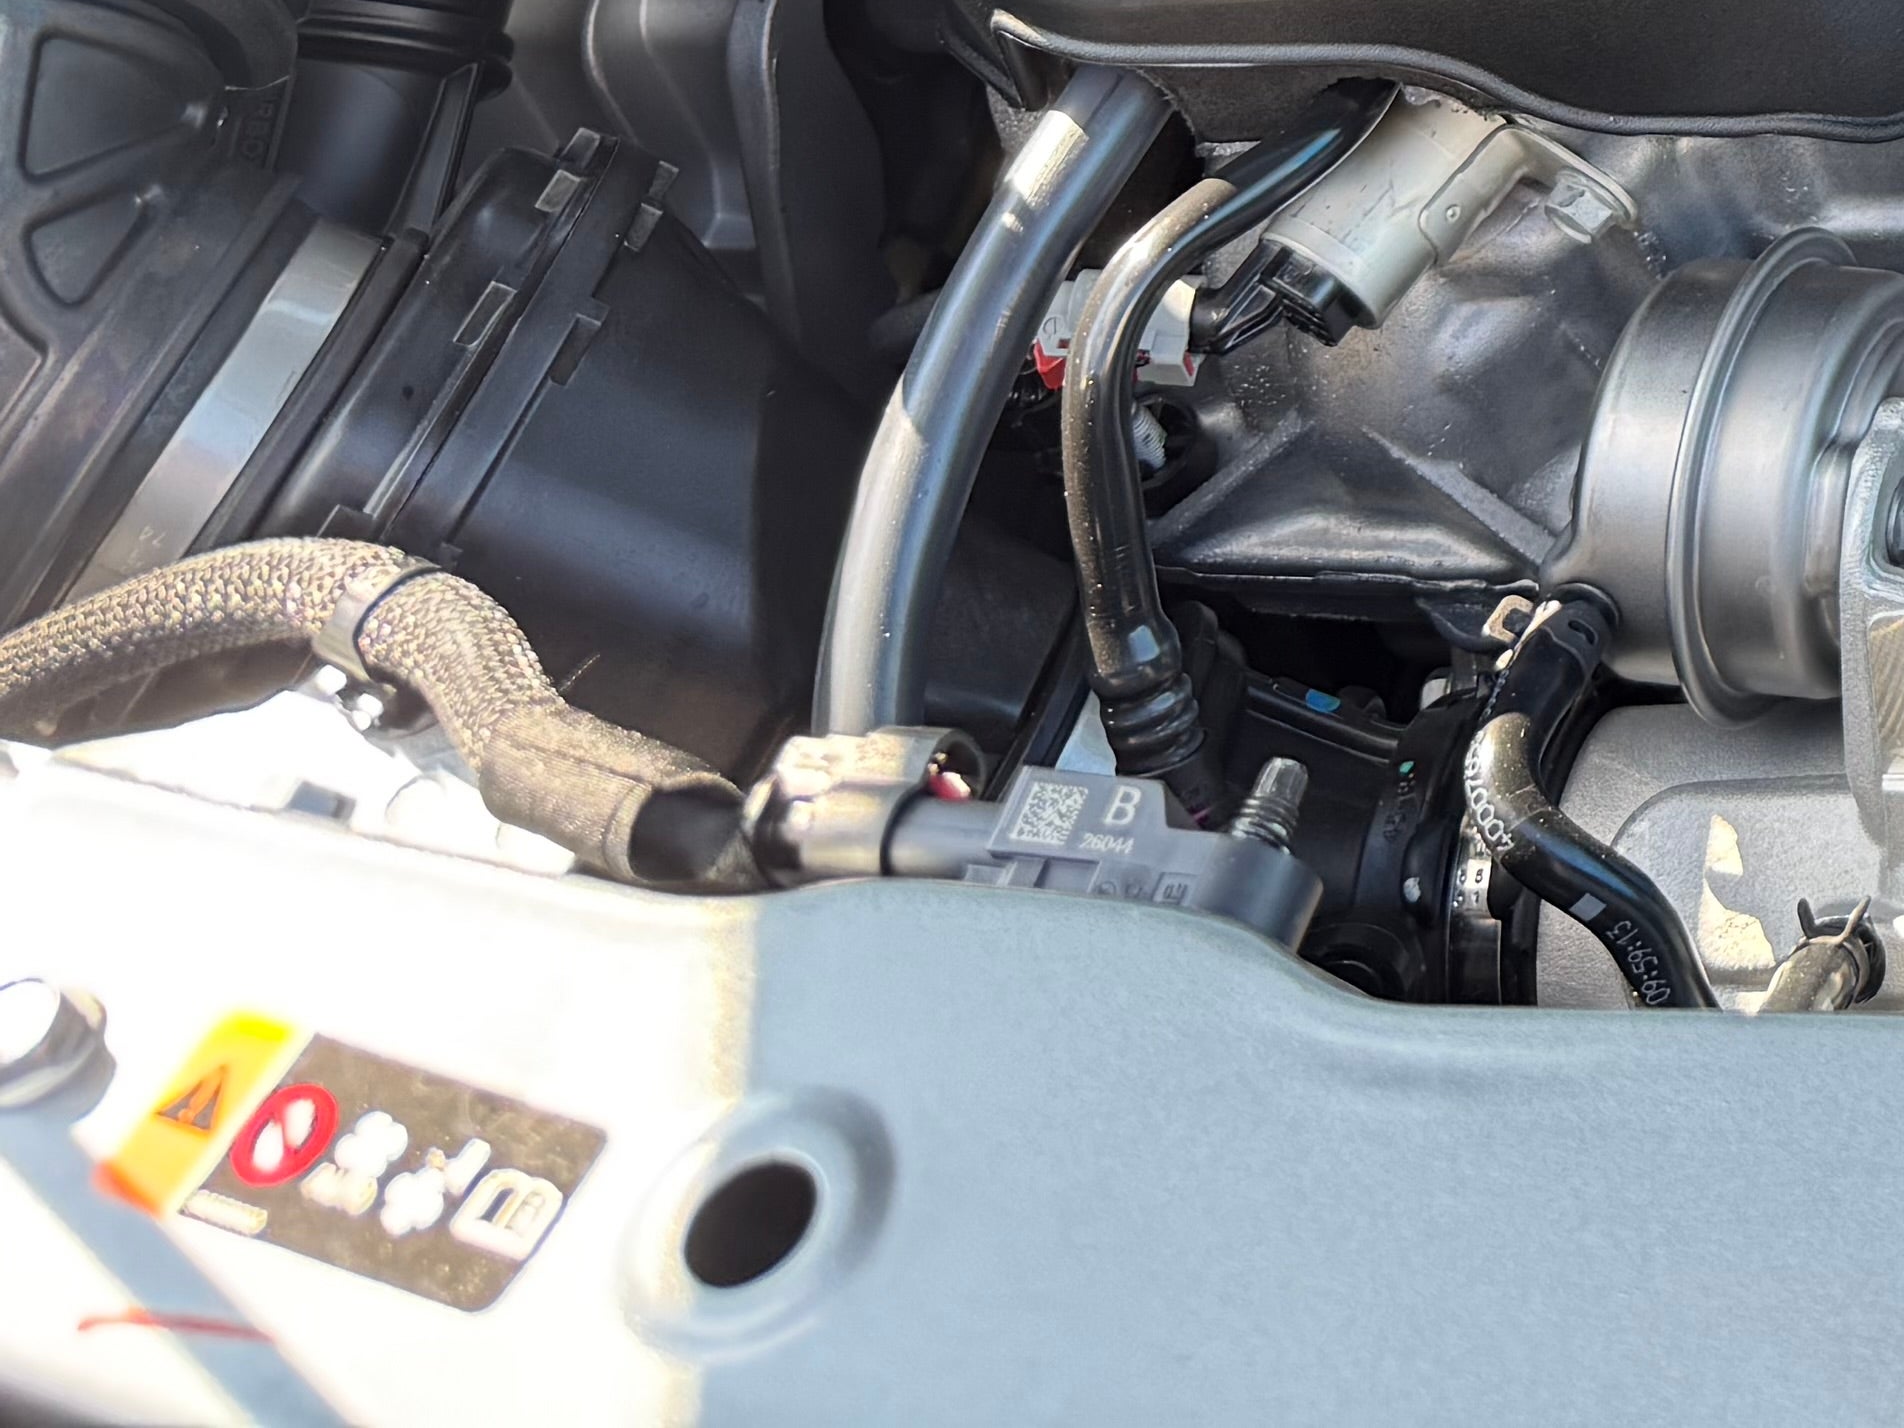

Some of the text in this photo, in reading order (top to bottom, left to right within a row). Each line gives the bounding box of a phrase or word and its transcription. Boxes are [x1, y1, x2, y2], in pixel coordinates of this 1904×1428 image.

[1103, 784, 1142, 826] B
[1076, 831, 1136, 855] 26044
[1604, 919, 1671, 1006] 09:59:13
